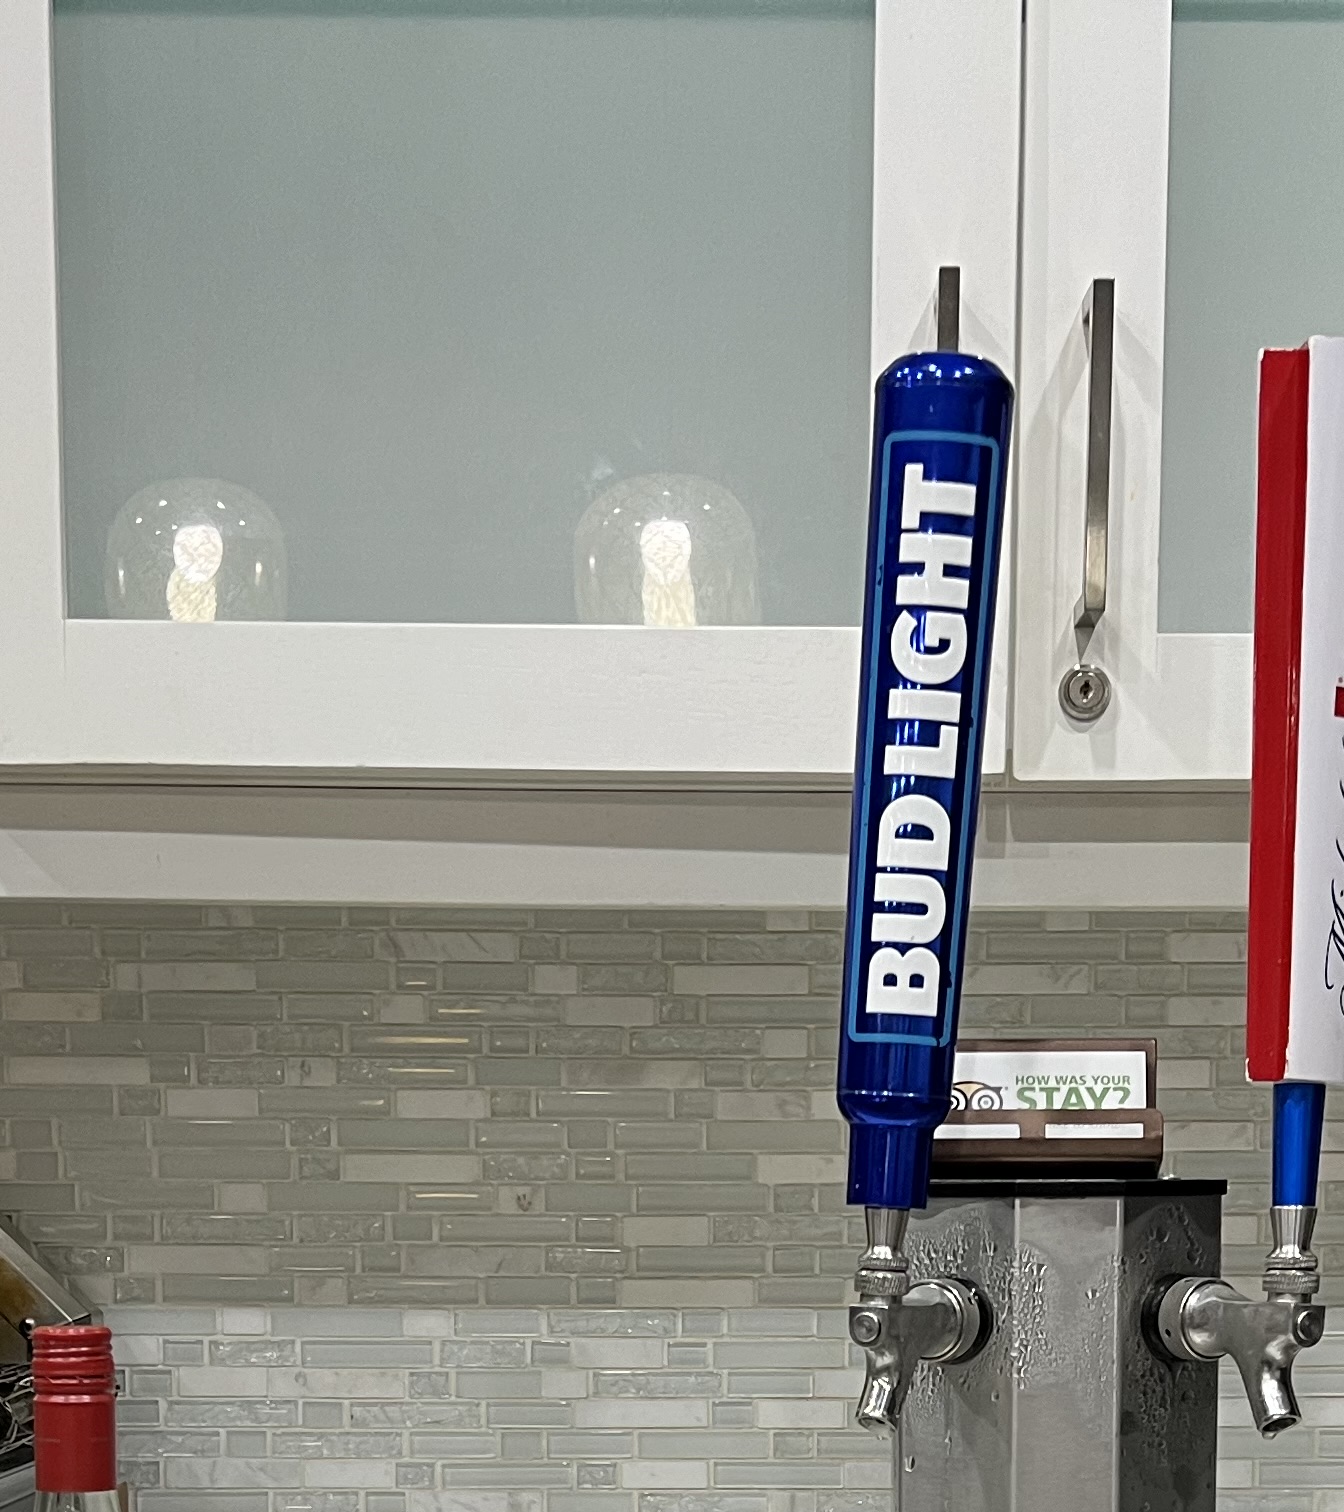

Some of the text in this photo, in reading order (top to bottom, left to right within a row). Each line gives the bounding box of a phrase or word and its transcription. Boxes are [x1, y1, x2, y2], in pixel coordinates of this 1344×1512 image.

[865, 462, 977, 1017] BUD LIGHT
[1015, 1075, 1131, 1086] HOW WAS YOUR
[1016, 1087, 1131, 1110] STAY?
